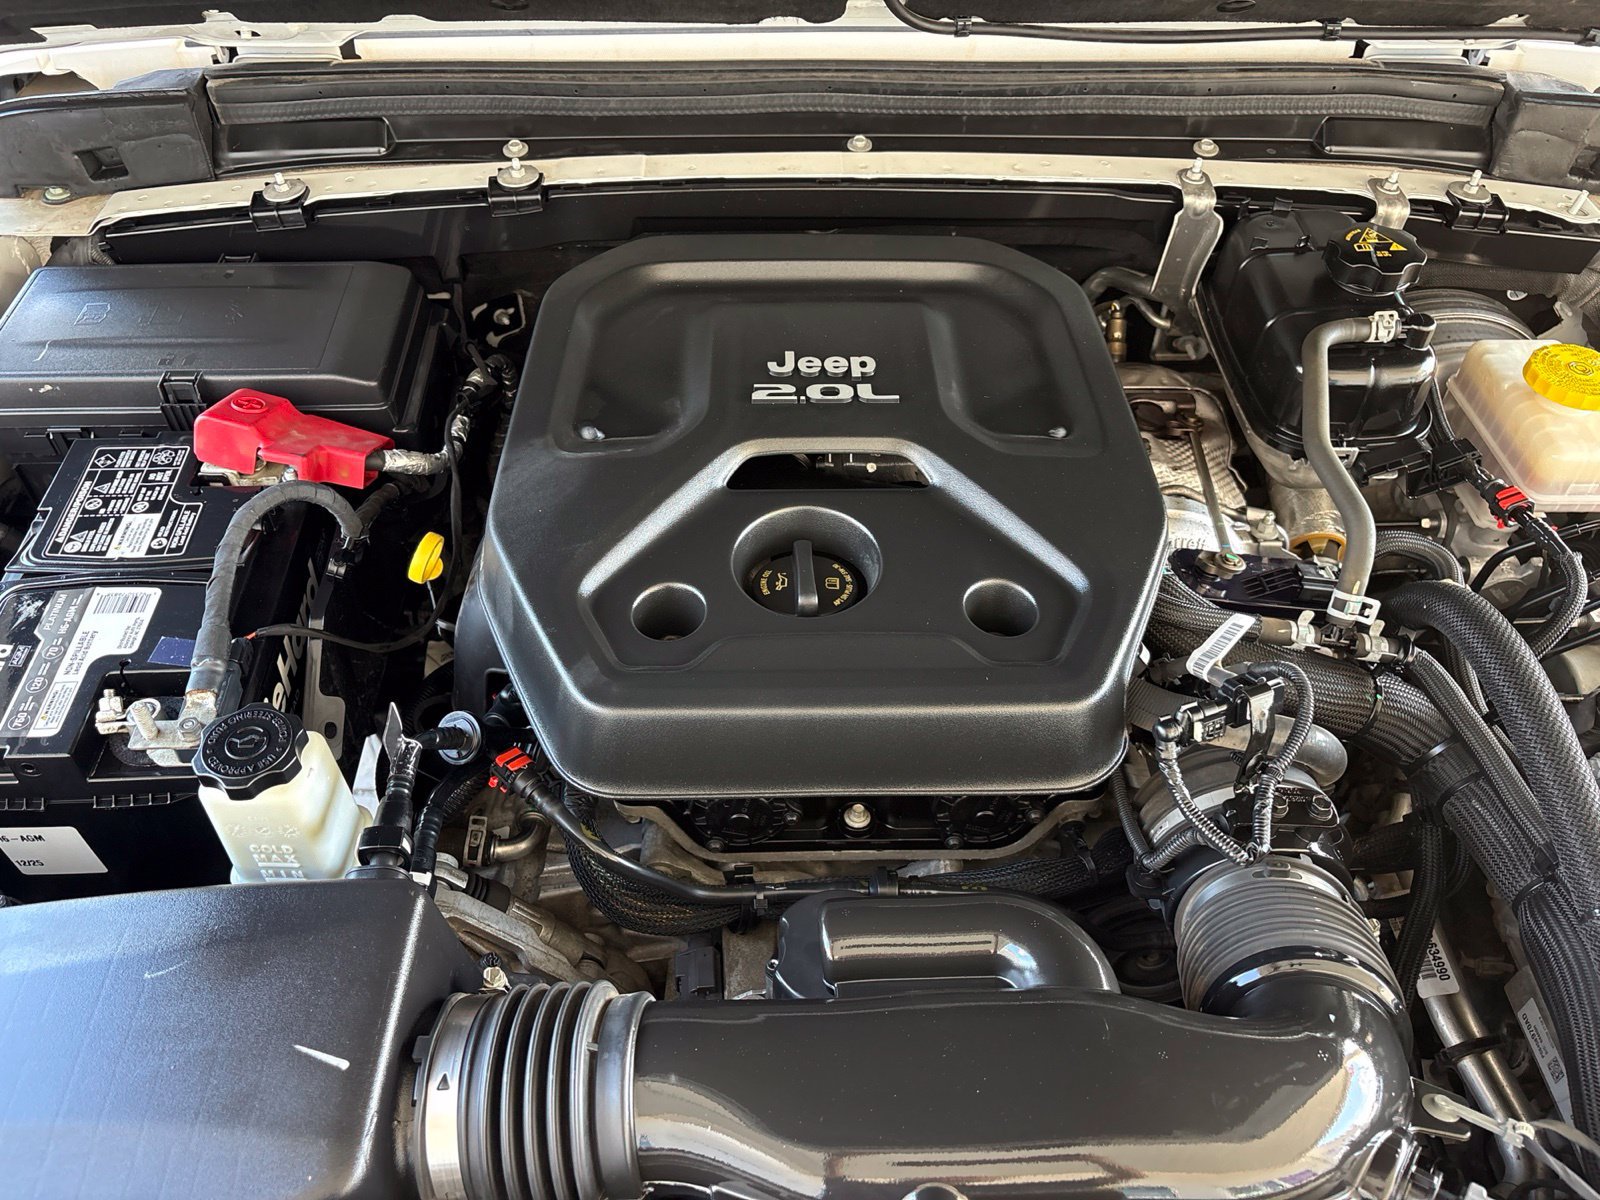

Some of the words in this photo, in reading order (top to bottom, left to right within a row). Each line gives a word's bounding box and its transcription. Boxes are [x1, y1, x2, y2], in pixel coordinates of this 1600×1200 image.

[767, 350, 877, 380] Jeep
[751, 383, 900, 404] 2.0L
[60, 481, 93, 538] DANGER/POISON
[170, 510, 191, 548] NON-SPILLABLE
[44, 594, 68, 630] PLATINUM
[58, 604, 78, 635] H6-AGM
[13, 645, 25, 665] AGM
[46, 646, 57, 657] 70
[64, 631, 90, 675] NON-SPILLABLE
[31, 677, 44, 690] 120
[13, 712, 28, 727] 760
[227, 710, 274, 725] STEERING
[207, 756, 255, 774] APPROVED
[258, 753, 276, 768] USE
[248, 844, 294, 854] COLD
[15, 859, 44, 867] 12/25
[252, 854, 299, 863] MAX
[260, 869, 305, 879] MIN
[1427, 938, 1451, 982] 634990
